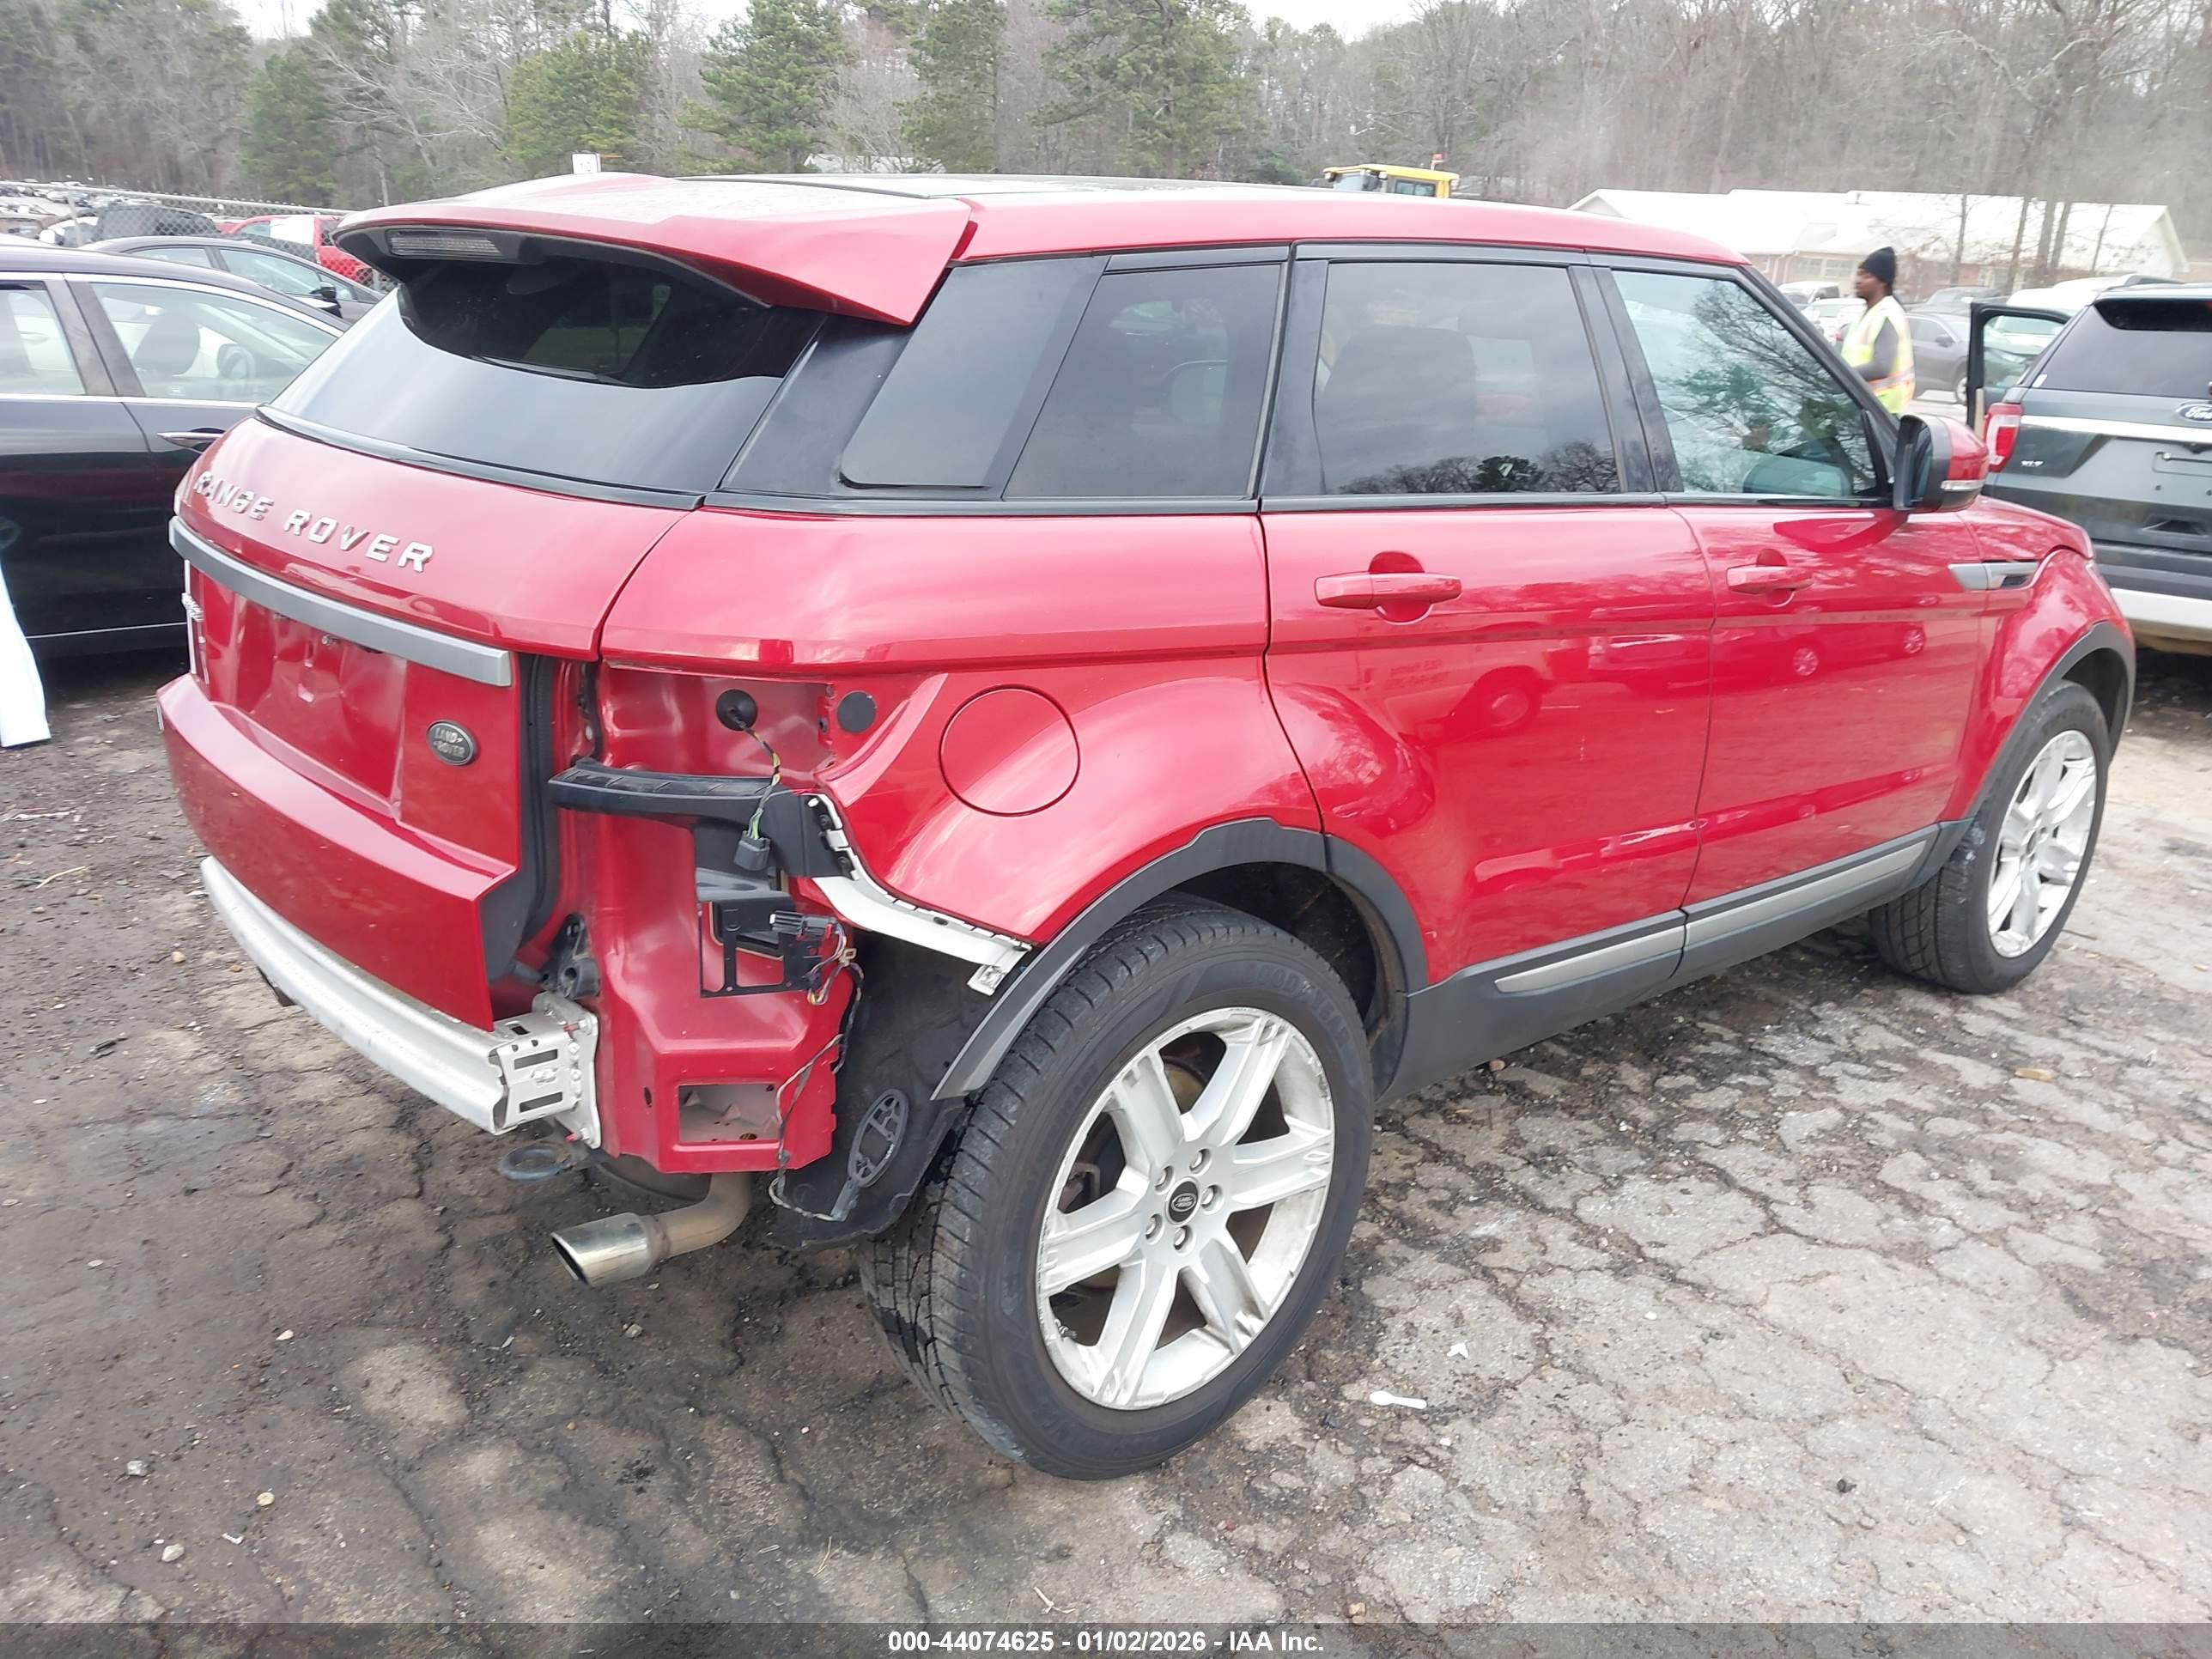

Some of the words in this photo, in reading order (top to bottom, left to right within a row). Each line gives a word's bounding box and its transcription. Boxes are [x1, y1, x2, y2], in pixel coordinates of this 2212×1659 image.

[193, 471, 274, 520] RANGE
[283, 508, 434, 573] ROVER
[434, 726, 459, 744] LAND
